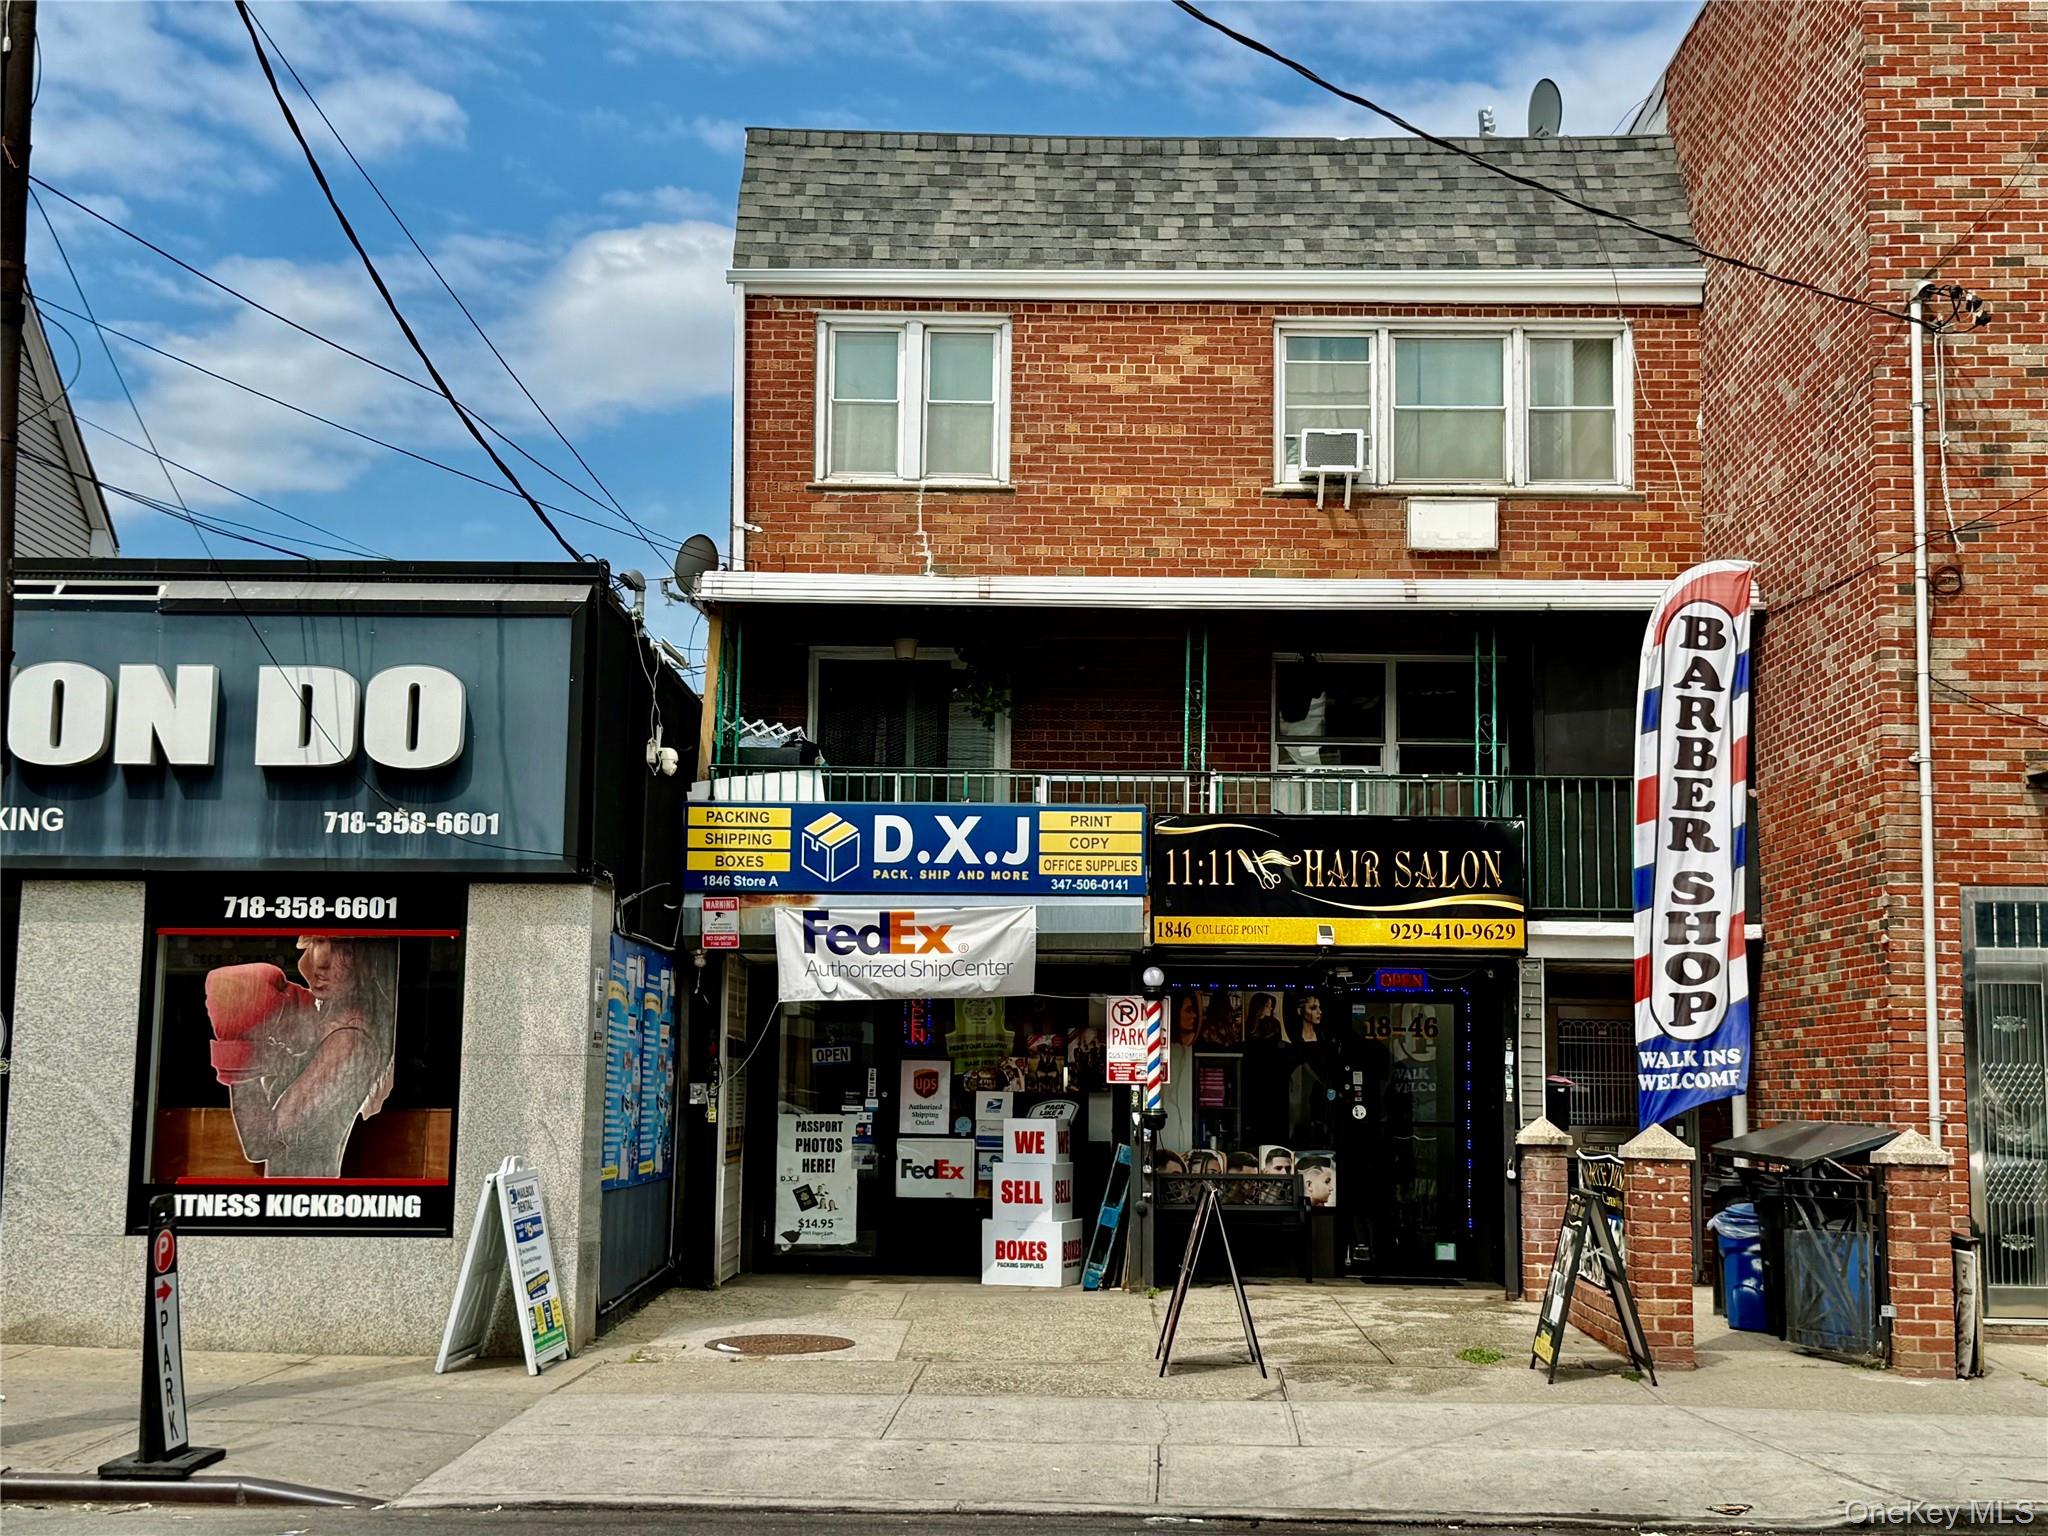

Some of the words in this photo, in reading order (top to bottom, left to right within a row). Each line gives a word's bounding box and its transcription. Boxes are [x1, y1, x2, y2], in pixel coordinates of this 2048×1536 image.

[8, 660, 220, 766] ON
[255, 664, 466, 768] DO
[1666, 615, 1726, 853] BARBER
[324, 811, 499, 835] 718-358-6601
[706, 811, 770, 823] PACKING
[1070, 815, 1113, 828] PRINT
[705, 833, 772, 846] SHIPPING
[873, 814, 1030, 866] D.X.J
[1069, 837, 1109, 850] COPY
[715, 855, 764, 868] BOXES
[1043, 859, 1082, 872] OFFICE
[1085, 859, 1138, 873] SUPPLIES
[1166, 848, 1236, 886] 11:11
[1302, 848, 1382, 888] HAIR
[1394, 849, 1503, 890] SALON
[702, 875, 731, 887] 1846
[733, 876, 766, 888] Store
[768, 876, 779, 887] A
[919, 870, 951, 880] SHIP
[957, 871, 985, 881] AND
[991, 872, 1030, 882] MORE
[1051, 878, 1129, 892] 347-506-0141
[223, 895, 398, 919] 718-358-6601
[705, 899, 736, 911] WARNING
[803, 911, 954, 956] FedEx
[1157, 921, 1192, 938] 1846
[1195, 924, 1239, 936] COLLEGE
[1241, 924, 1270, 936] POINT
[1390, 923, 1516, 941] 929-410-9629
[1663, 870, 1722, 1028] SHOP
[805, 961, 906, 978] Authorized
[910, 959, 1014, 982] ShipCenter
[1380, 973, 1424, 988] OPEN
[1364, 1014, 1439, 1040] 18-46
[816, 1048, 849, 1062] OPEN
[1639, 1051, 1699, 1069] WALK
[1703, 1049, 1742, 1065] INS
[915, 1080, 937, 1098] ups
[1638, 1069, 1741, 1091] WELCOME
[911, 1111, 940, 1120] Shipping
[795, 1121, 843, 1132] PASSPORT
[795, 1138, 843, 1152] PHOTOS
[1014, 1131, 1045, 1154] WE
[1057, 1131, 1070, 1154] WE
[802, 1158, 836, 1173] HERE!
[900, 1159, 964, 1180] FedEx
[1001, 1180, 1043, 1204] SELL
[1055, 1180, 1071, 1203] SELL
[174, 1194, 260, 1217] ITNESS
[265, 1195, 422, 1218] KICKBOXING
[798, 1219, 834, 1229] $14.95
[995, 1239, 1047, 1261] BOXES
[160, 1309, 180, 1441] PARK
